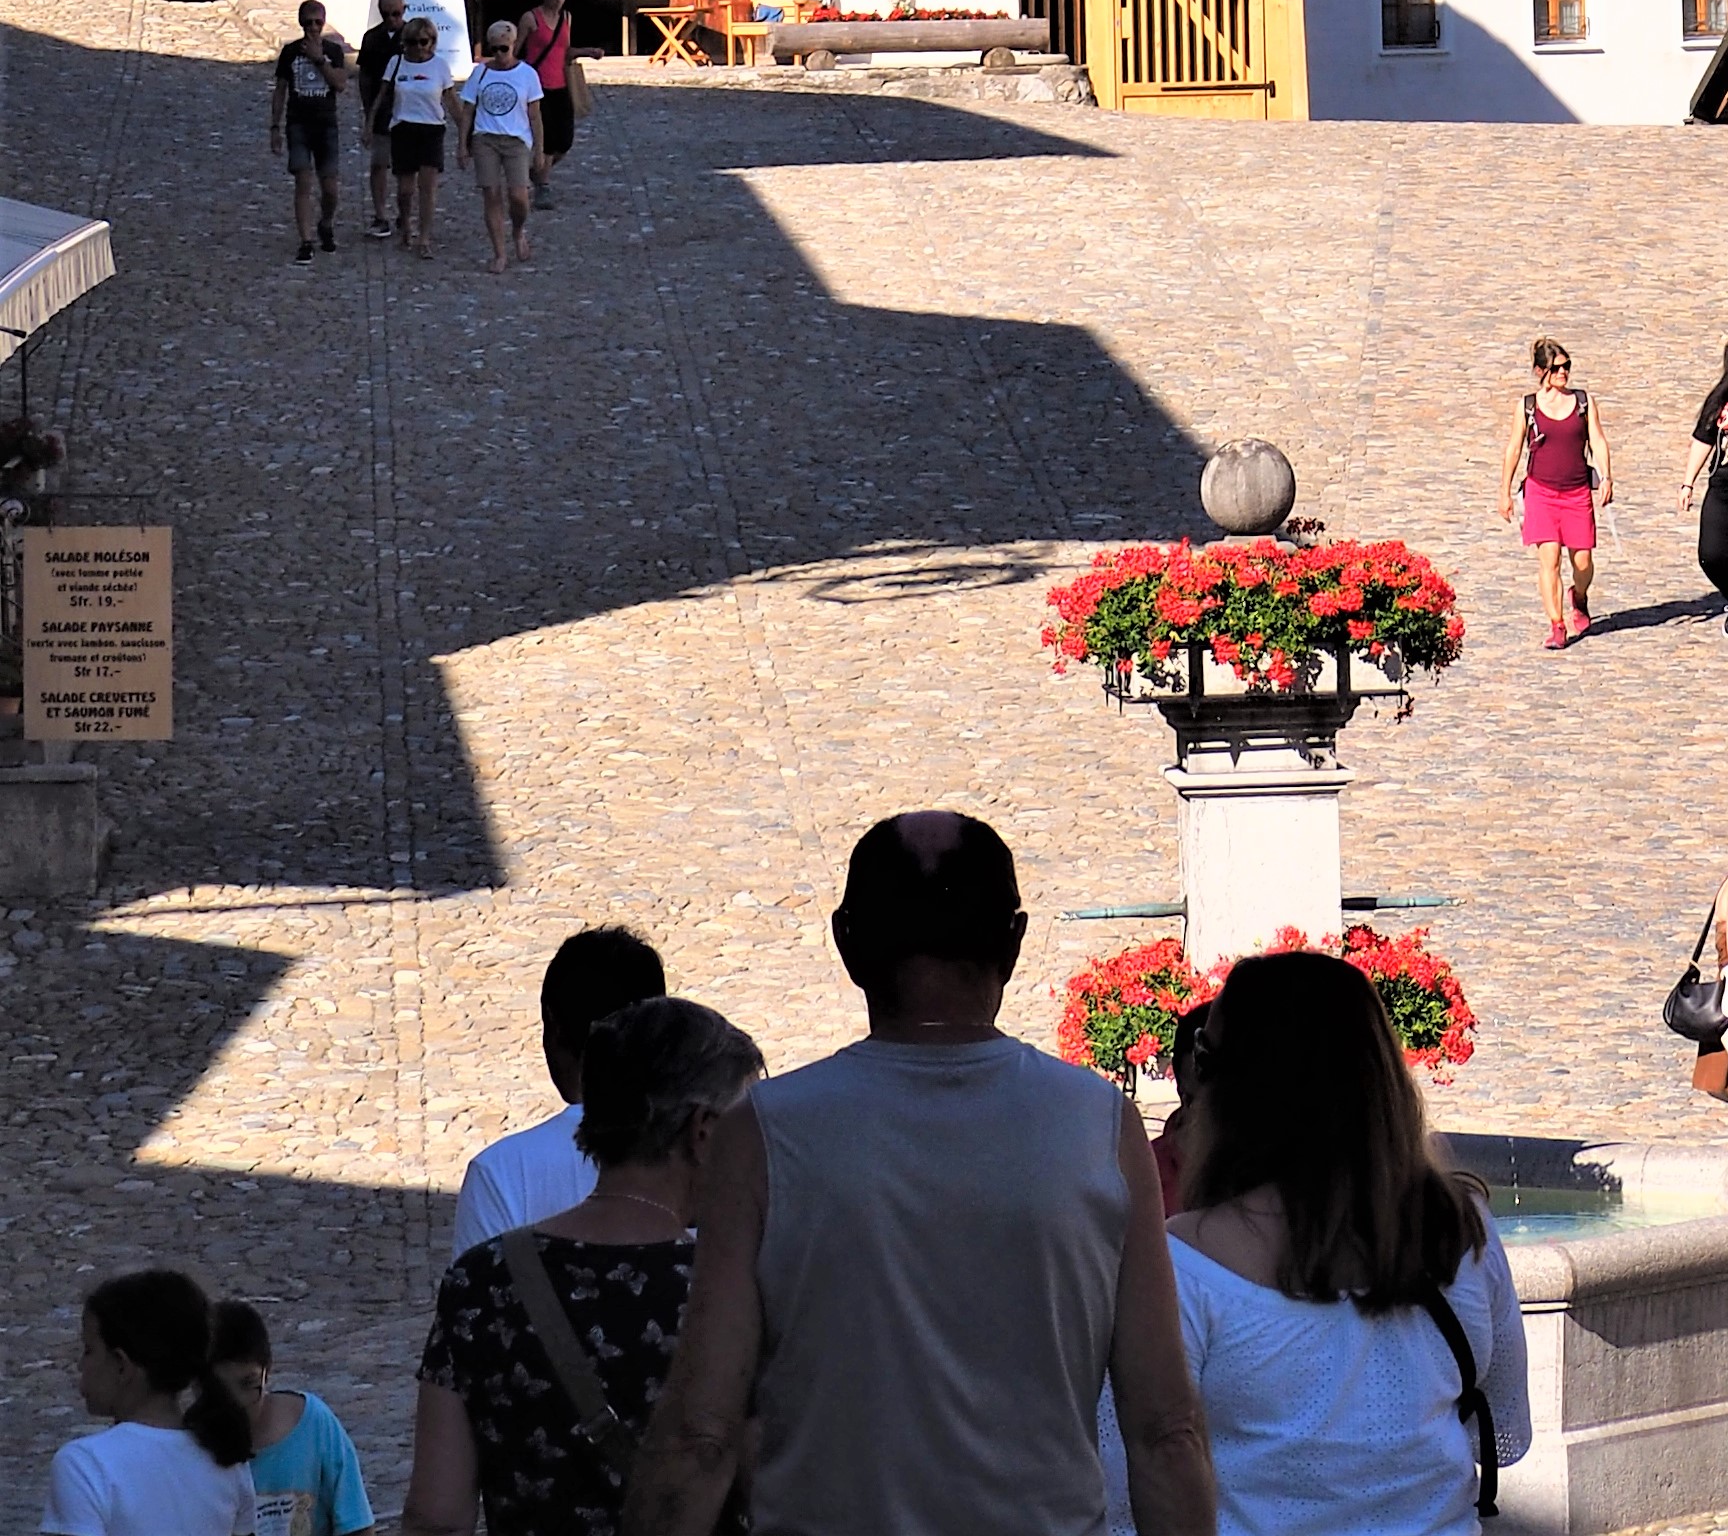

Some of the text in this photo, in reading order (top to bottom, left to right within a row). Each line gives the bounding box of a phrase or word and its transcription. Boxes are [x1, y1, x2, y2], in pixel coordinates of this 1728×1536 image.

[407, 3, 446, 13] Galerie
[45, 549, 150, 563] SALADE MOLÉSON
[57, 583, 67, 592] et
[69, 582, 100, 592] viande
[70, 596, 93, 607] Sfr.
[42, 621, 153, 633] SALADE PAYSANNE
[57, 639, 78, 648] avec
[90, 653, 100, 662] et
[74, 666, 91, 677] Sfr
[40, 692, 156, 703] SALADE CREVETTES
[46, 705, 150, 718] ET SAUMON FUMÉ
[75, 722, 92, 733] Sfr
